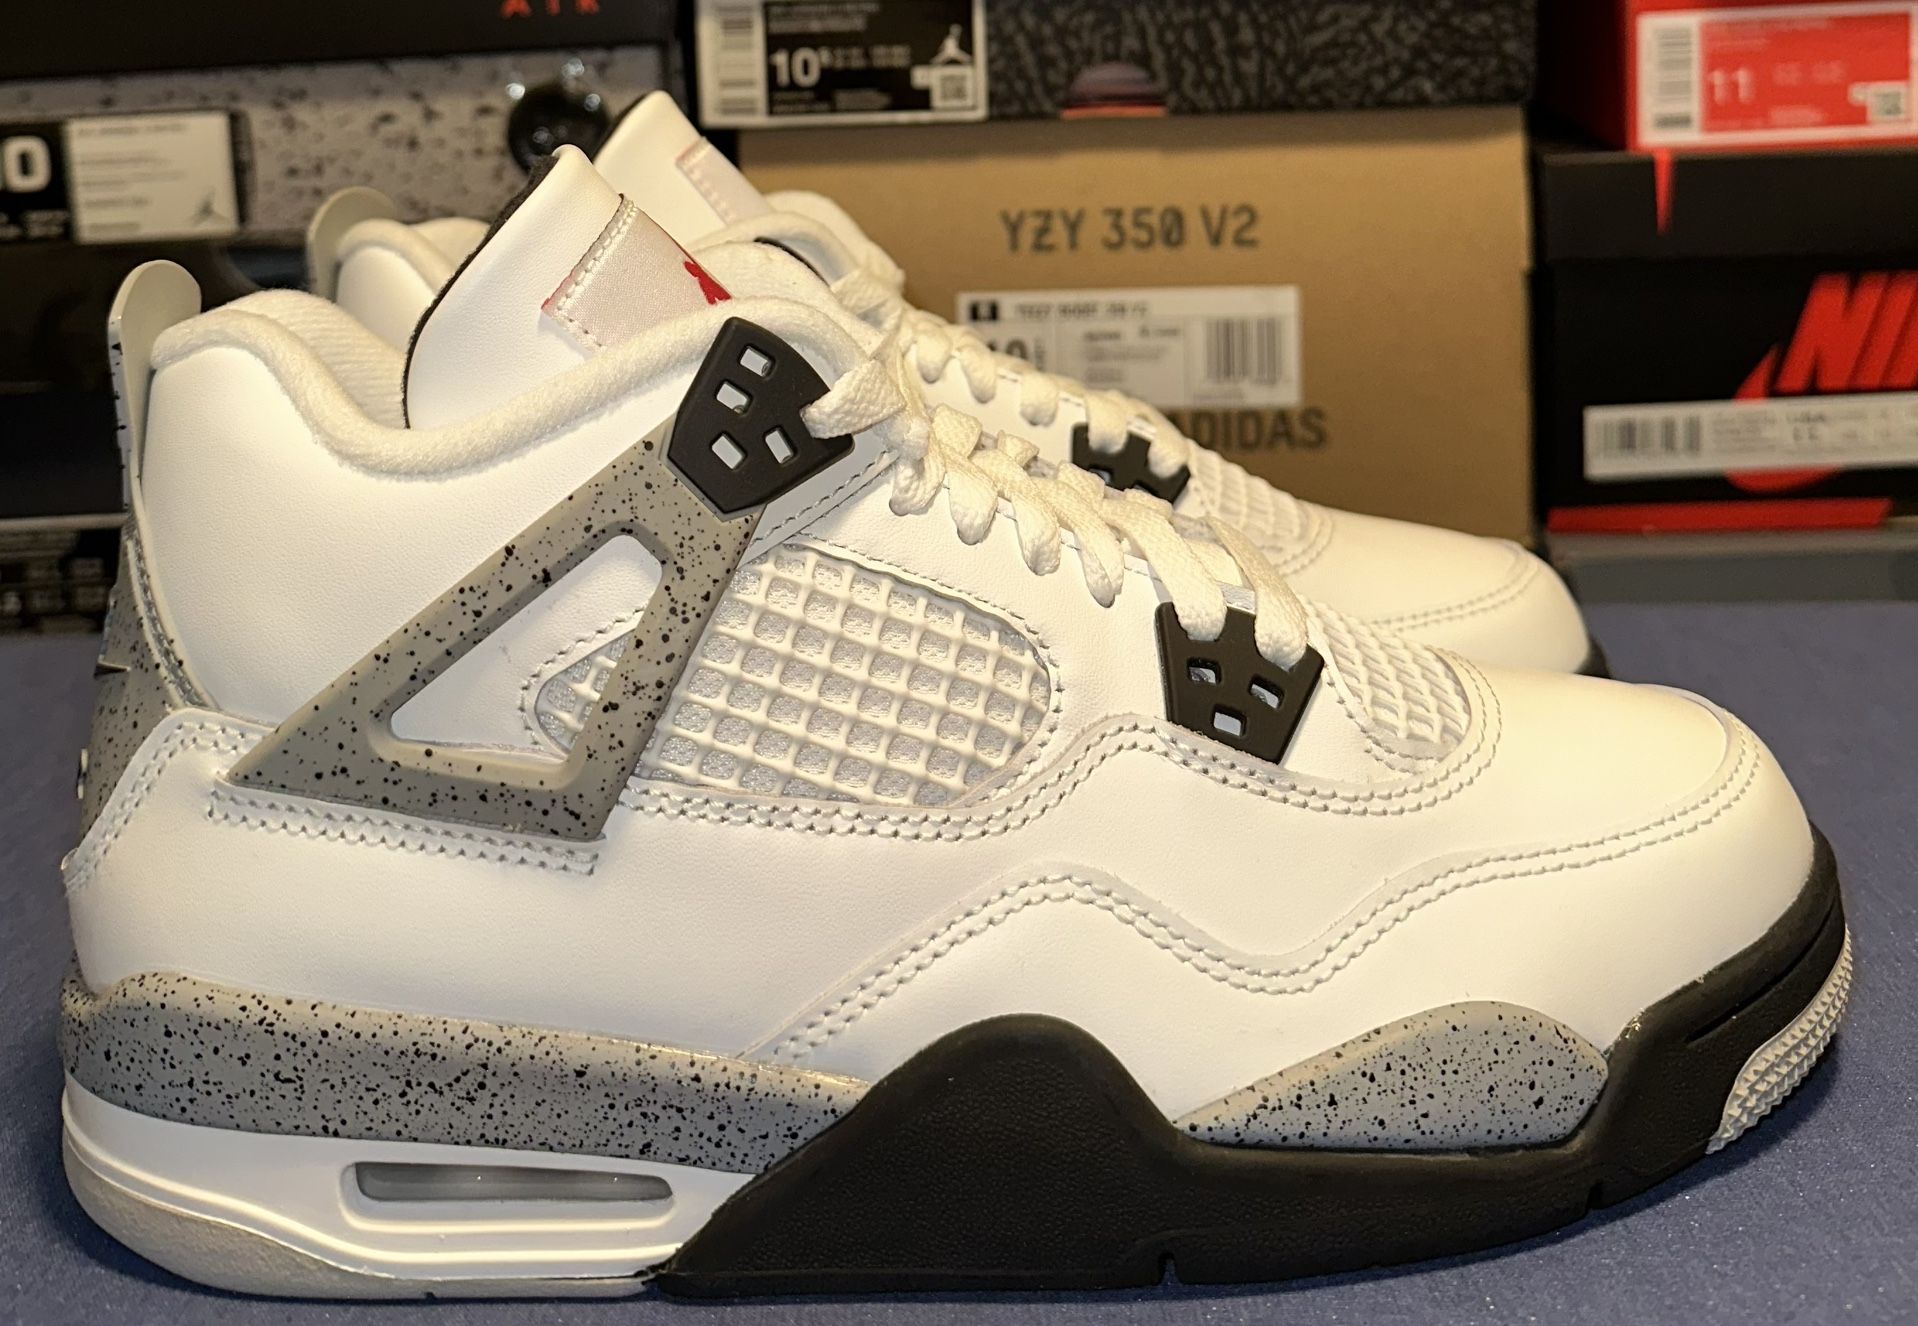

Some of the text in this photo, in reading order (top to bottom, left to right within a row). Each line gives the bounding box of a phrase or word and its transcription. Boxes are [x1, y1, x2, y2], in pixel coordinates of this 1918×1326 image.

[999, 203, 1259, 252] YZY 350 V2
[1776, 271, 1918, 393] NI
